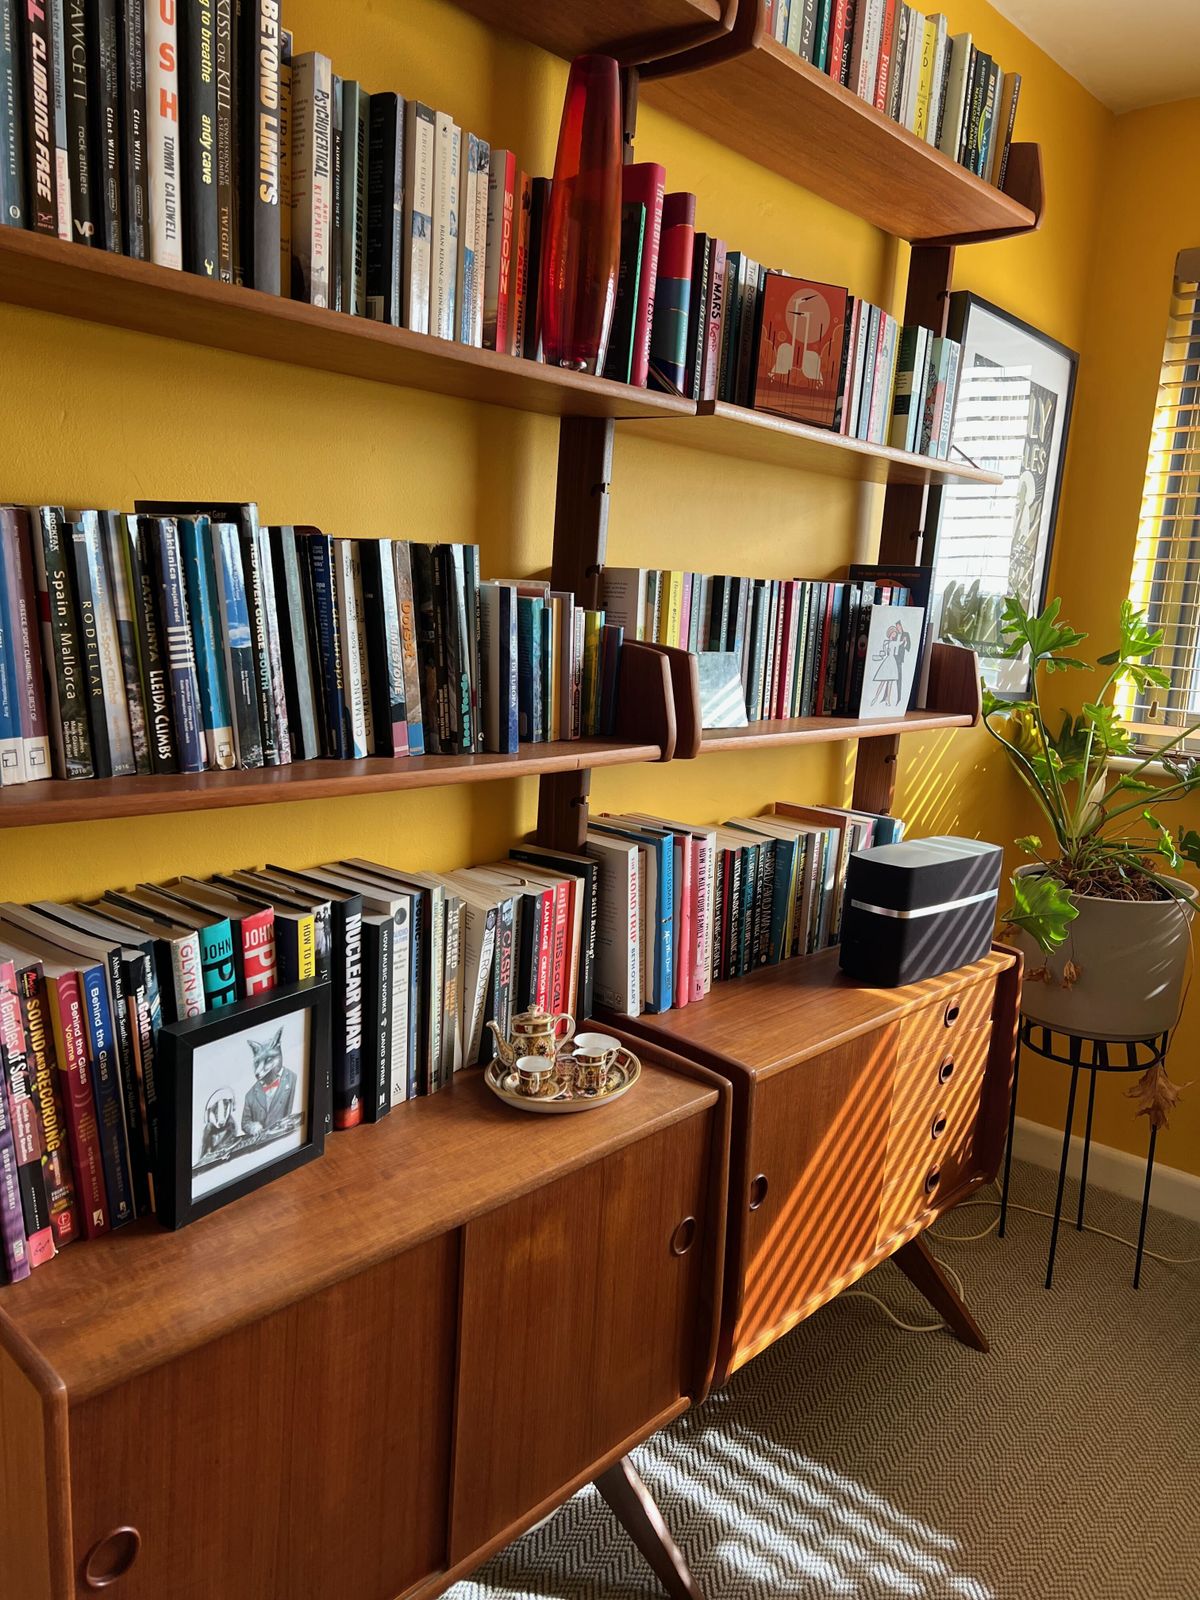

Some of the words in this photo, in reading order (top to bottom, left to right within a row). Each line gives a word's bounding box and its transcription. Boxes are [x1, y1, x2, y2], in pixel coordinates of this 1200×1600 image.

[3, 7, 12, 55] SUMMIT
[200, 11, 212, 24] to
[217, 0, 231, 39] KISS
[802, 16, 813, 45] Fry
[201, 27, 212, 83] breathe
[217, 42, 226, 64] OR
[259, 0, 280, 110] BEYOND
[833, 33, 842, 62] Fry
[6, 68, 15, 118] STEPHEN
[31, 32, 49, 143] CLIMBING
[217, 68, 231, 112] KILL
[878, 53, 891, 97] Funny
[979, 66, 987, 86] BRIEF
[105, 106, 114, 133] Clint
[971, 86, 980, 121] MARLON
[976, 87, 985, 116] HISTORY
[77, 125, 86, 152] rock
[132, 108, 141, 136] Clint
[200, 114, 213, 150] andy
[967, 123, 976, 150] JAMES
[8, 122, 17, 176] VENABLES
[107, 138, 116, 170] Willis
[134, 140, 143, 171] Willis
[163, 135, 175, 180] TOMMY
[259, 113, 279, 206] LIMITS
[355, 118, 366, 195] MOUNTAIN
[419, 127, 428, 165] FERGUS
[451, 132, 460, 177] Facing
[35, 142, 52, 202] FREE
[79, 154, 88, 195] athlete
[202, 151, 214, 184] cave
[57, 183, 67, 226] MacLeod
[418, 166, 427, 209] FLEMING
[164, 182, 177, 241] CALDWELL
[313, 184, 323, 257] KIRKPATRICK
[652, 208, 663, 249] RABBIT
[220, 206, 230, 262] TWIGHT
[354, 198, 364, 278] DISASTERS
[439, 224, 447, 245] BRIAN
[438, 247, 446, 276] KEENAN
[500, 221, 511, 295] DOWN
[649, 254, 659, 292] HUTCH
[711, 282, 723, 320] MARS
[697, 305, 706, 352] DELICATE
[694, 359, 703, 392] TRUTH
[940, 402, 953, 442] CRISIS
[50, 512, 61, 551] ROCKFAX
[164, 525, 178, 580] Paklenica
[54, 570, 71, 616] Spain
[252, 567, 264, 606] RIVER
[19, 599, 28, 626] GREECE
[141, 575, 160, 663] CATALUNYA
[255, 608, 267, 650] GORGE
[401, 600, 416, 660] Dorset
[22, 627, 31, 648] SPORT
[82, 600, 103, 697] RODELLAR
[99, 636, 111, 667] Sport
[59, 633, 77, 700] Mallorca
[259, 651, 270, 691] SOUTH
[334, 632, 346, 690] Europa
[386, 622, 403, 695] LIMESTONE
[149, 670, 166, 713] LLEIDA
[352, 678, 364, 738] CLIMBING
[154, 714, 172, 760] CLIMBS
[591, 865, 600, 881] Are
[666, 840, 674, 878] RICHARD
[698, 847, 708, 864] HOW
[698, 865, 706, 876] TO
[705, 847, 714, 879] period
[590, 882, 599, 896] We
[628, 872, 638, 909] ROAD
[698, 876, 706, 894] KILL
[414, 899, 424, 941] SONIC
[447, 910, 453, 926] OF
[451, 909, 459, 933] THE
[543, 900, 551, 924] ALAN
[589, 897, 598, 918] Still
[697, 894, 705, 914] YOUR
[243, 922, 275, 950] JOHN
[303, 924, 313, 946] HOW
[436, 901, 444, 951] ADVENTURES
[542, 924, 550, 951] McGEE
[556, 926, 564, 957] THIS
[588, 919, 599, 959] Rolling?
[628, 913, 638, 945] TRIP
[696, 914, 705, 940] FAMILY
[202, 938, 232, 963] JOHN
[303, 947, 312, 961] TO
[346, 912, 363, 1003] NUCLEAR
[450, 934, 458, 969] SPEED
[484, 930, 495, 959] NILE
[500, 929, 513, 987] CASH
[112, 956, 123, 977] Abbey
[179, 943, 197, 993] GLYN
[540, 956, 548, 993] CREATION
[115, 978, 125, 998] Road
[134, 985, 147, 1005] The
[381, 982, 389, 1014] WORKS
[448, 977, 457, 1016] THOMAS
[474, 959, 491, 1020] RODGERS
[493, 990, 501, 1013] MOON
[553, 982, 562, 1013] CALL
[0, 997, 19, 1049] Temples
[24, 999, 47, 1051] SOUND
[70, 1002, 85, 1038] Behind
[89, 987, 106, 1028] Behind
[116, 999, 127, 1019] Brian
[63, 1023, 76, 1062] Volume
[93, 1029, 106, 1048] the
[118, 1020, 130, 1049] Southall,
[136, 1004, 152, 1050] Golden
[345, 1004, 362, 1055] WAR
[380, 1031, 388, 1058] DAVID
[9, 1050, 23, 1063] of
[35, 1051, 46, 1070] AND
[74, 1039, 85, 1055] the
[76, 1055, 89, 1086] Glass
[97, 1049, 110, 1082] Glass
[143, 1049, 159, 1104] Moment
[379, 1058, 387, 1087] BYRNE
[13, 1065, 32, 1103] Sound
[22, 1102, 31, 1122] Inside
[36, 1070, 61, 1153] RECORDING
[1, 1148, 12, 1173] BOBBY
[18, 1138, 28, 1163] Studios
[26, 1133, 34, 1152] Great
[87, 1145, 96, 1173] HOWARD
[4, 1174, 16, 1211] OWSINSKI
[90, 1176, 99, 1203] MASSEY
